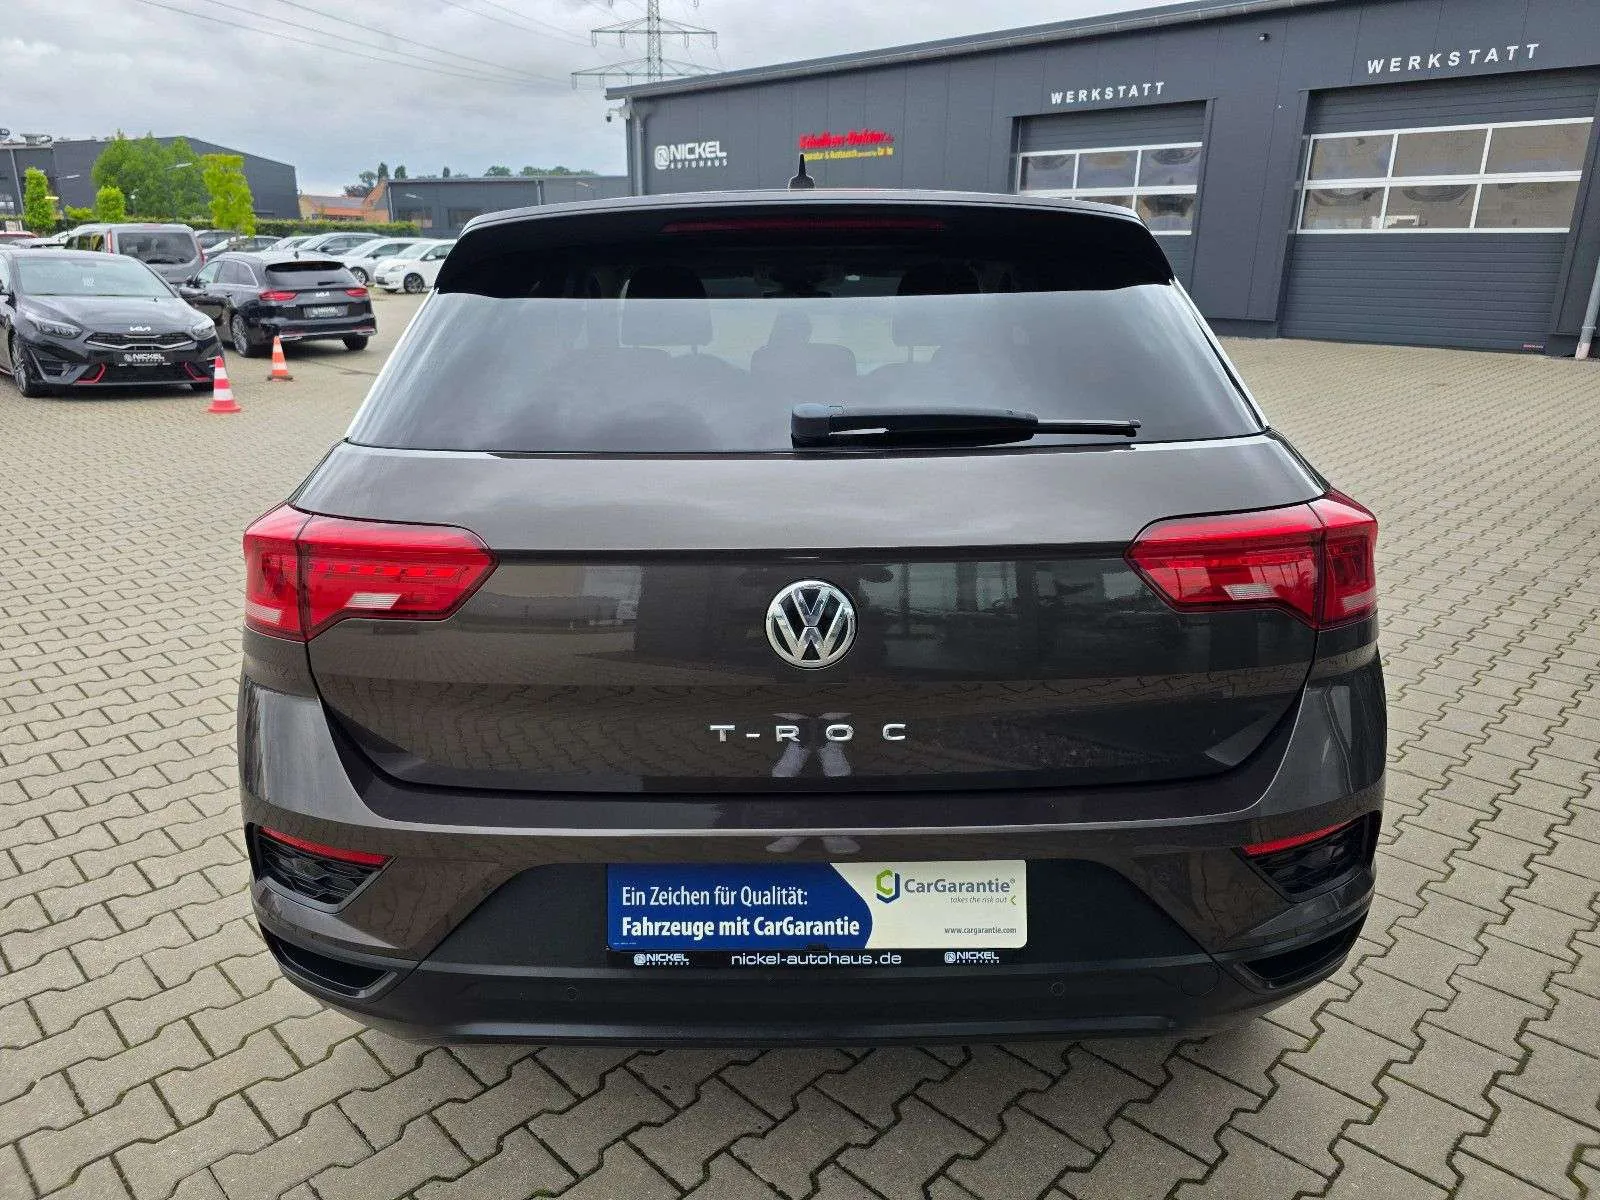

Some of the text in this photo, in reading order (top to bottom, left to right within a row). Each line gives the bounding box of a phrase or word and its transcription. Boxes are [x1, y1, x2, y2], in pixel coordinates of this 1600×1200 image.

[1367, 44, 1539, 74] WERKSTATT
[1051, 81, 1164, 104] WERKSTATT
[669, 140, 727, 160] NICKEL
[709, 723, 906, 742] T-ROC
[622, 886, 808, 908] Ein Zeichen für Qualität:
[622, 916, 860, 940] Fahrzeuge mit CarGarantie
[944, 926, 1017, 936] www.cargarantie.com
[646, 953, 690, 961] NICKEL
[731, 953, 902, 966] nickel-autohaus.de
[956, 952, 1000, 960] NICKEL
